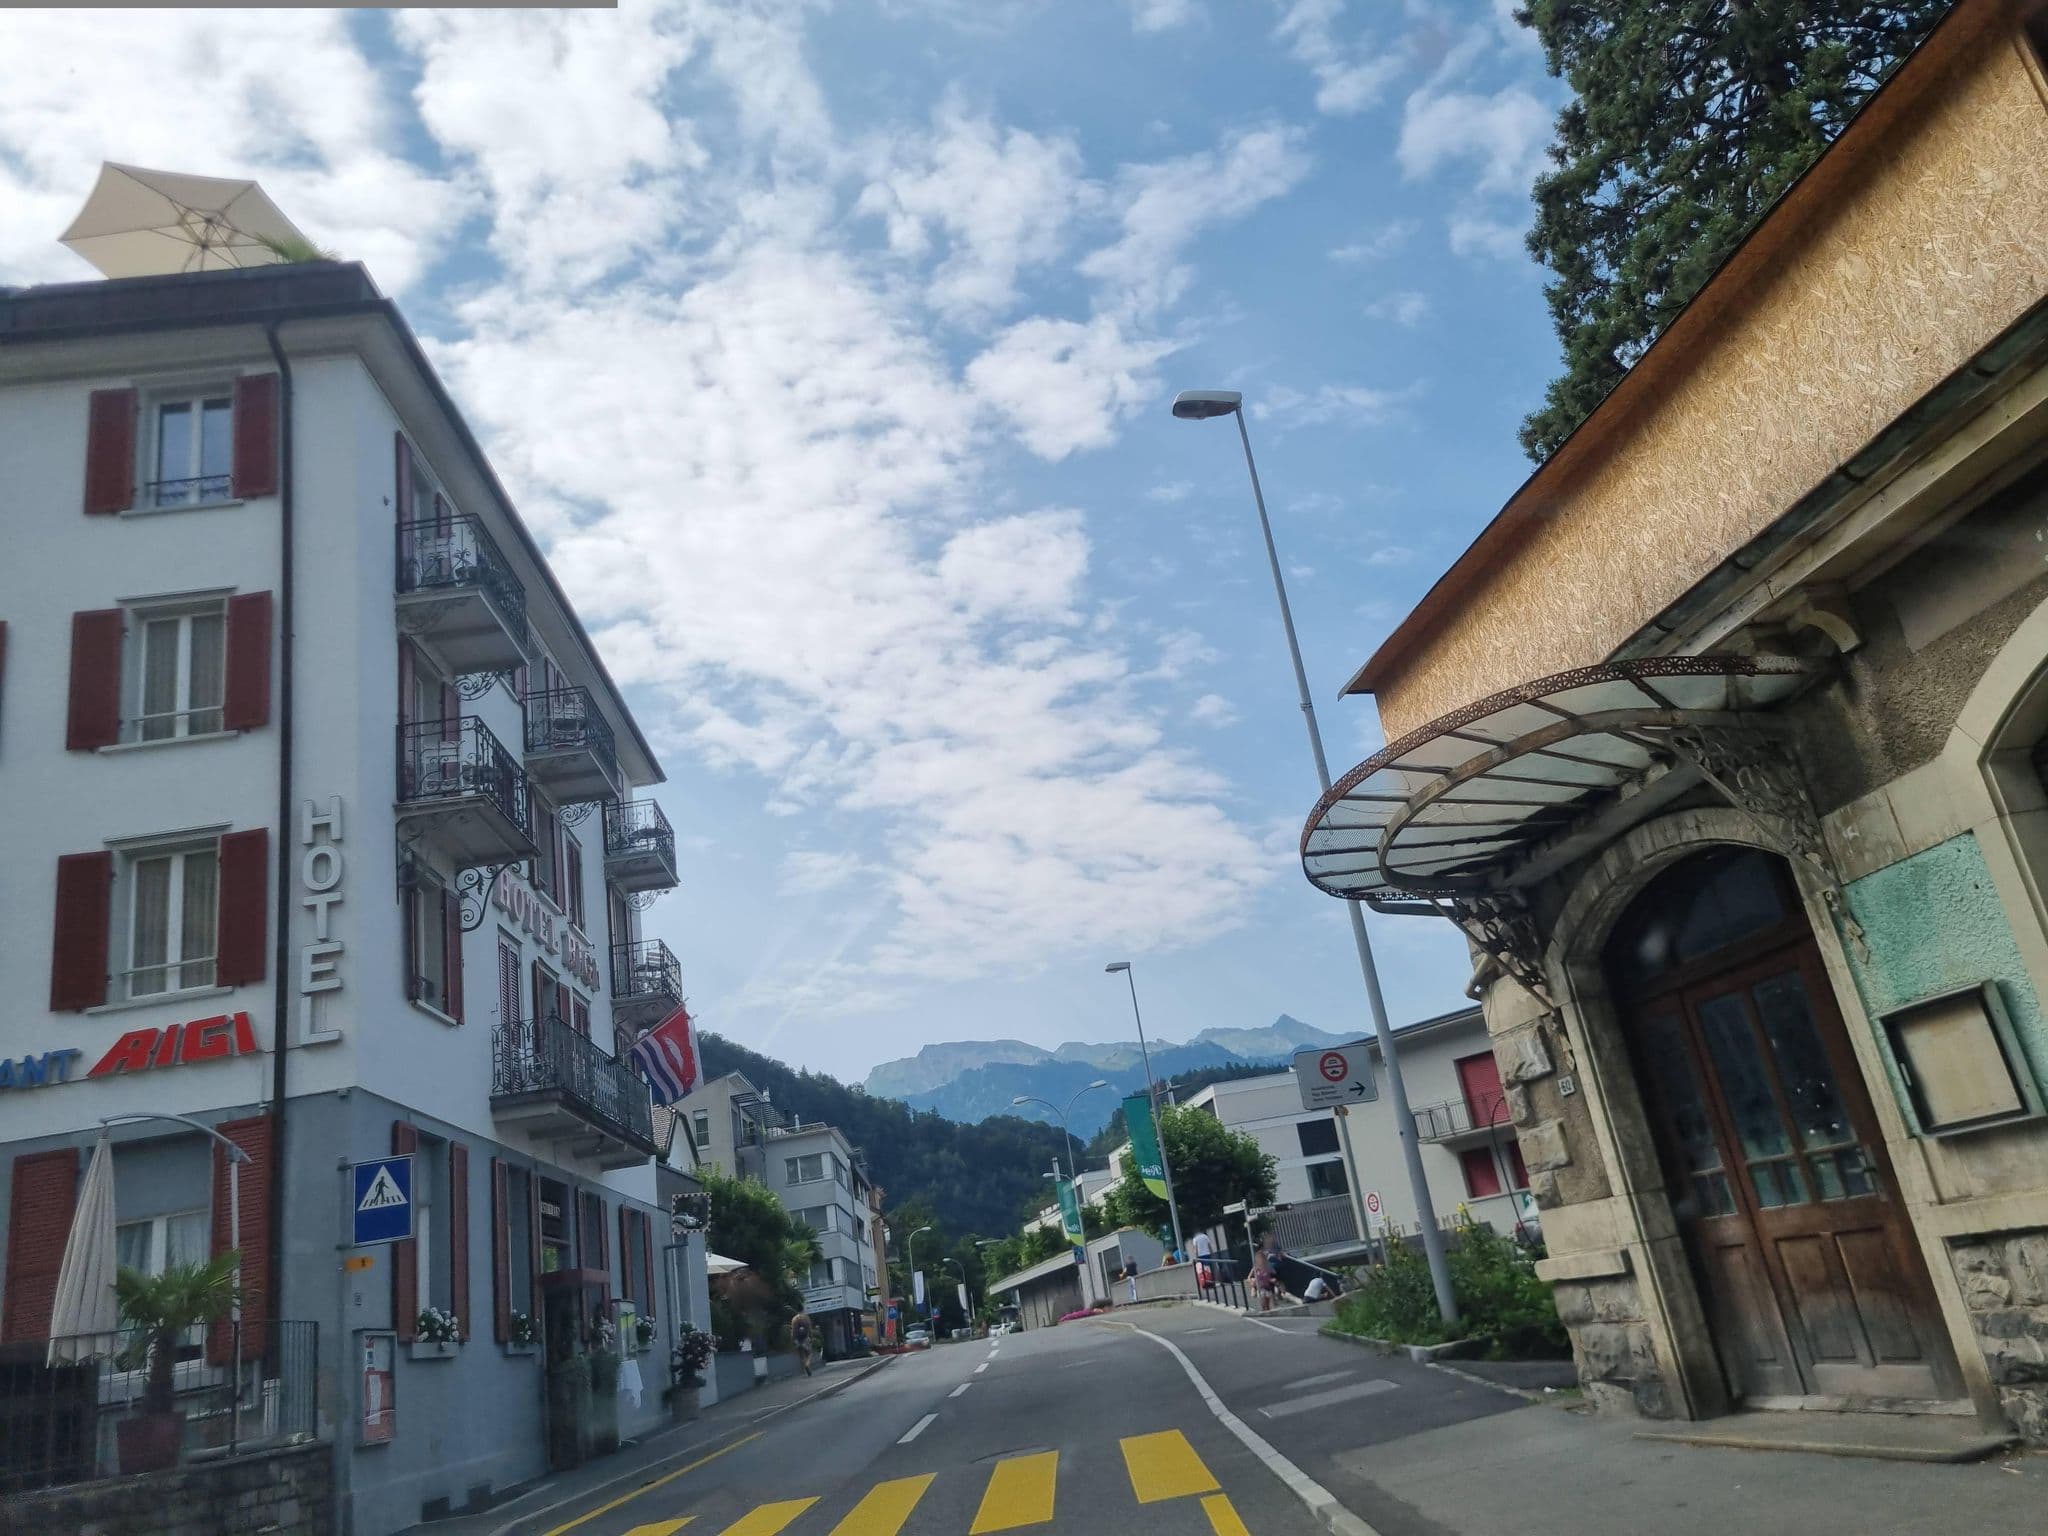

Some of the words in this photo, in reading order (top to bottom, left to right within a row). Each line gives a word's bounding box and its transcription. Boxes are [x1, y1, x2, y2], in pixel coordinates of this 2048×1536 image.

[301, 795, 344, 1046] HOTEL
[493, 868, 560, 955] HOTEL
[86, 1011, 257, 1079] RIGI
